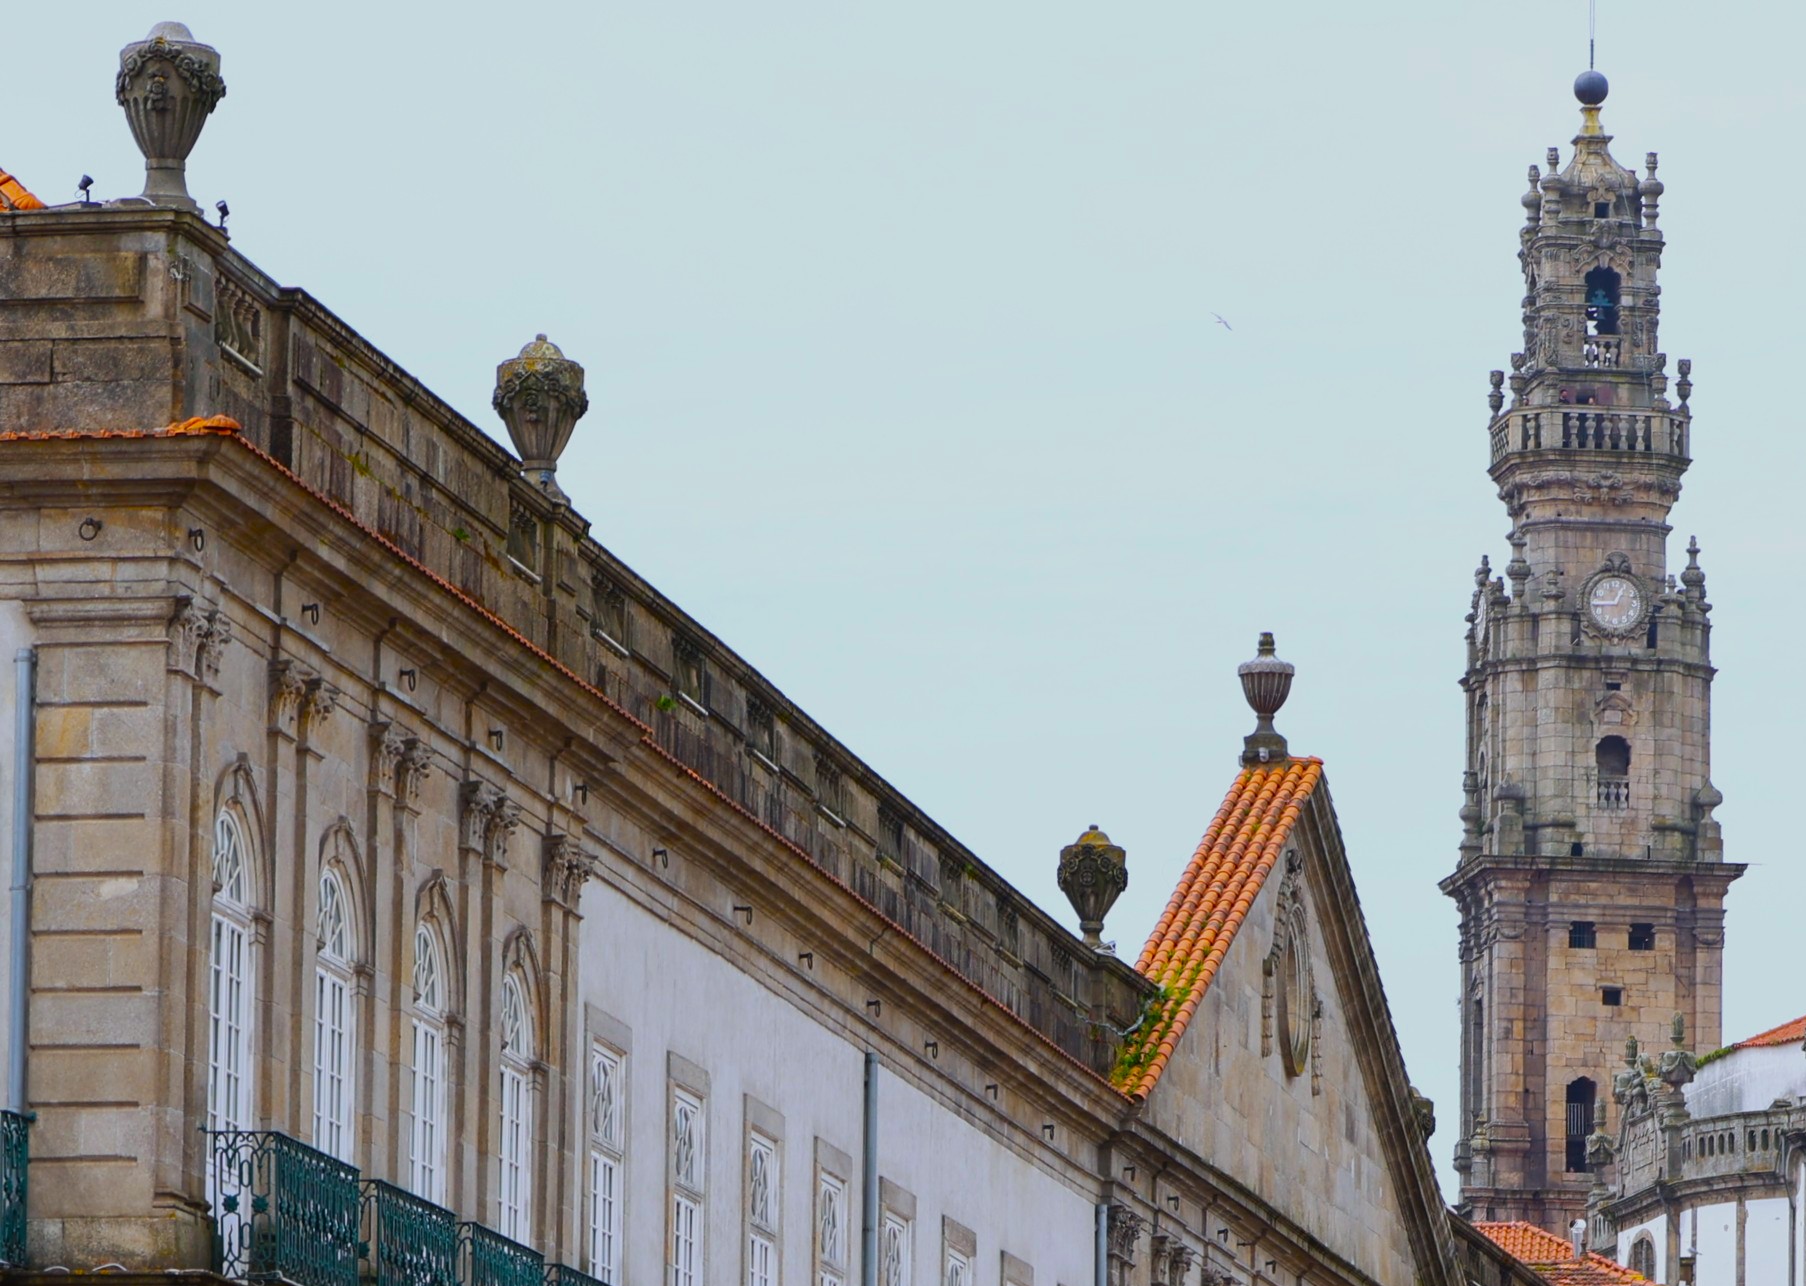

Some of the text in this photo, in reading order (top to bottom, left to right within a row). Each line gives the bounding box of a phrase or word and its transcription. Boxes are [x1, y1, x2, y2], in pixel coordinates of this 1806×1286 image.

[1603, 582, 1610, 590] 11
[1611, 580, 1620, 588] 12
[1629, 590, 1635, 598] 2
[1621, 615, 1628, 623] 5
